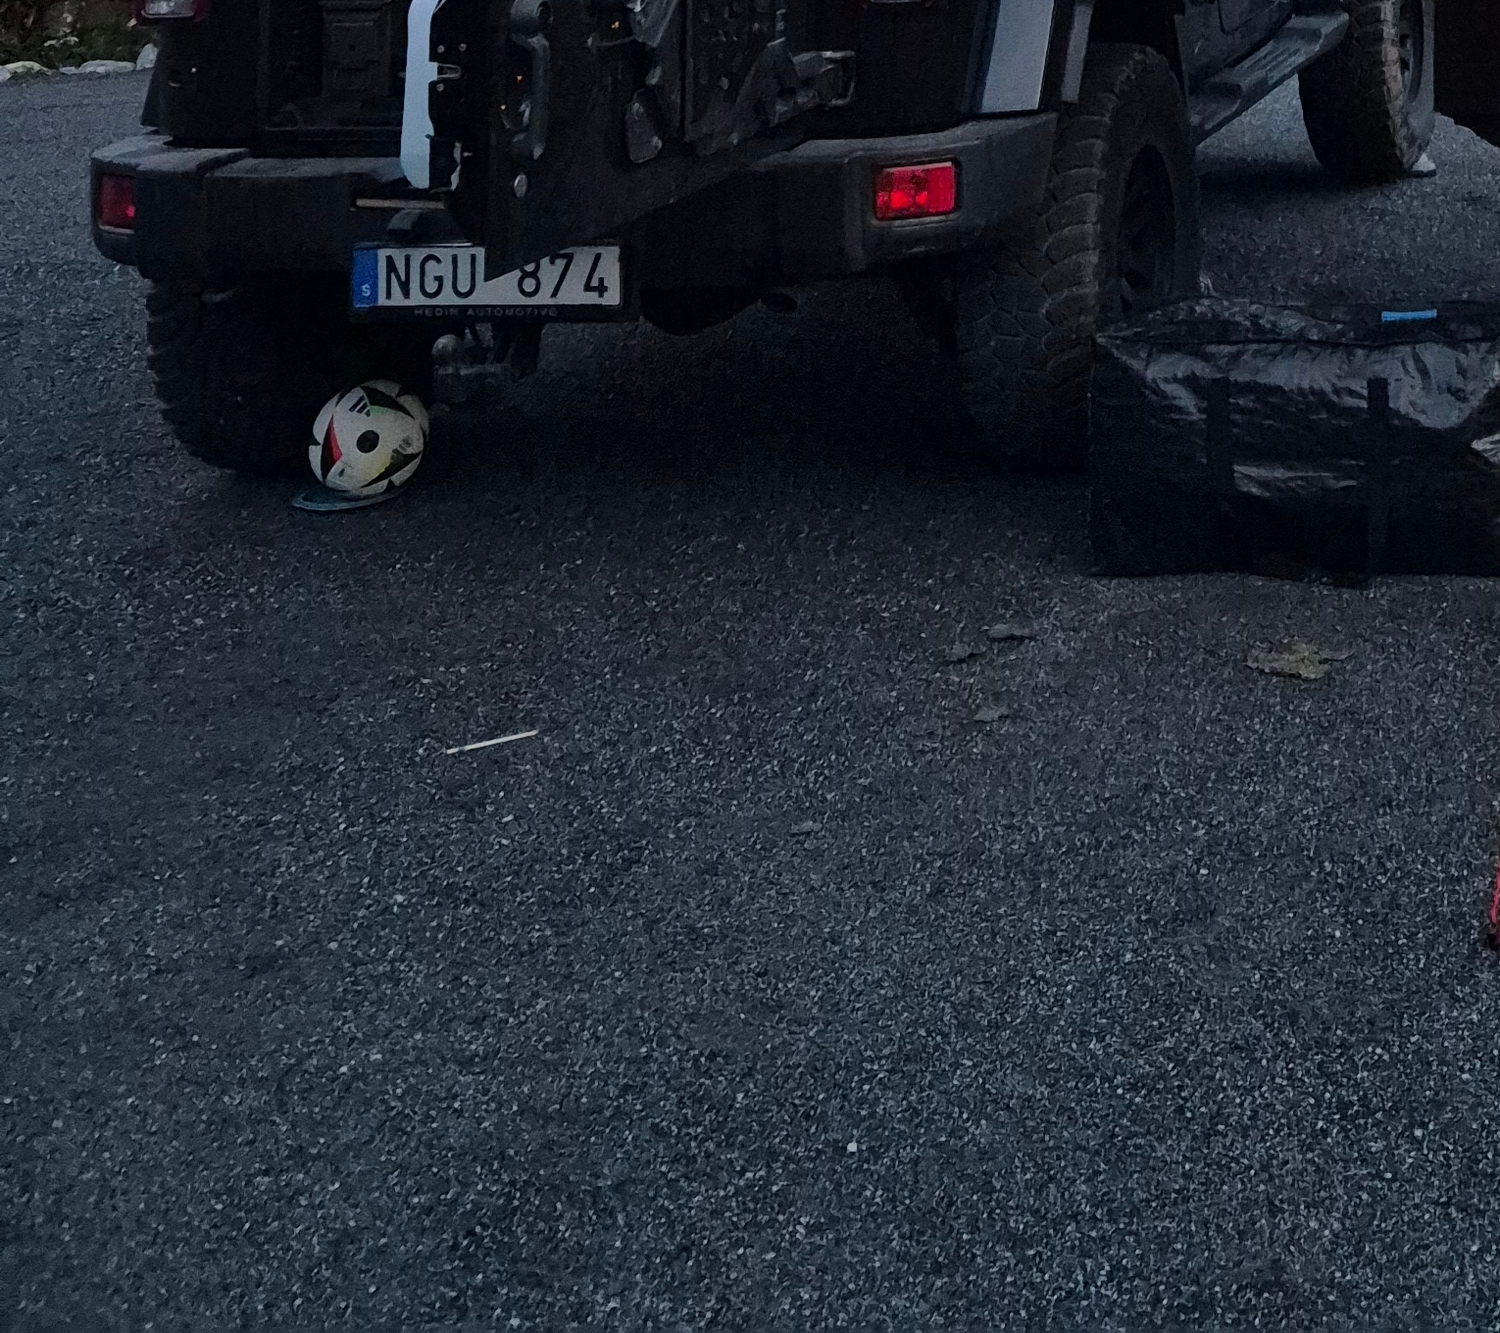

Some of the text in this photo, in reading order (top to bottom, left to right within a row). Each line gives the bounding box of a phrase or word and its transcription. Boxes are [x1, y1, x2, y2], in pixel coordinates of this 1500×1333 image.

[385, 252, 609, 300] NGU 874
[361, 283, 371, 297] S
[413, 307, 559, 318] HEDIN AUTOMOTIVE
